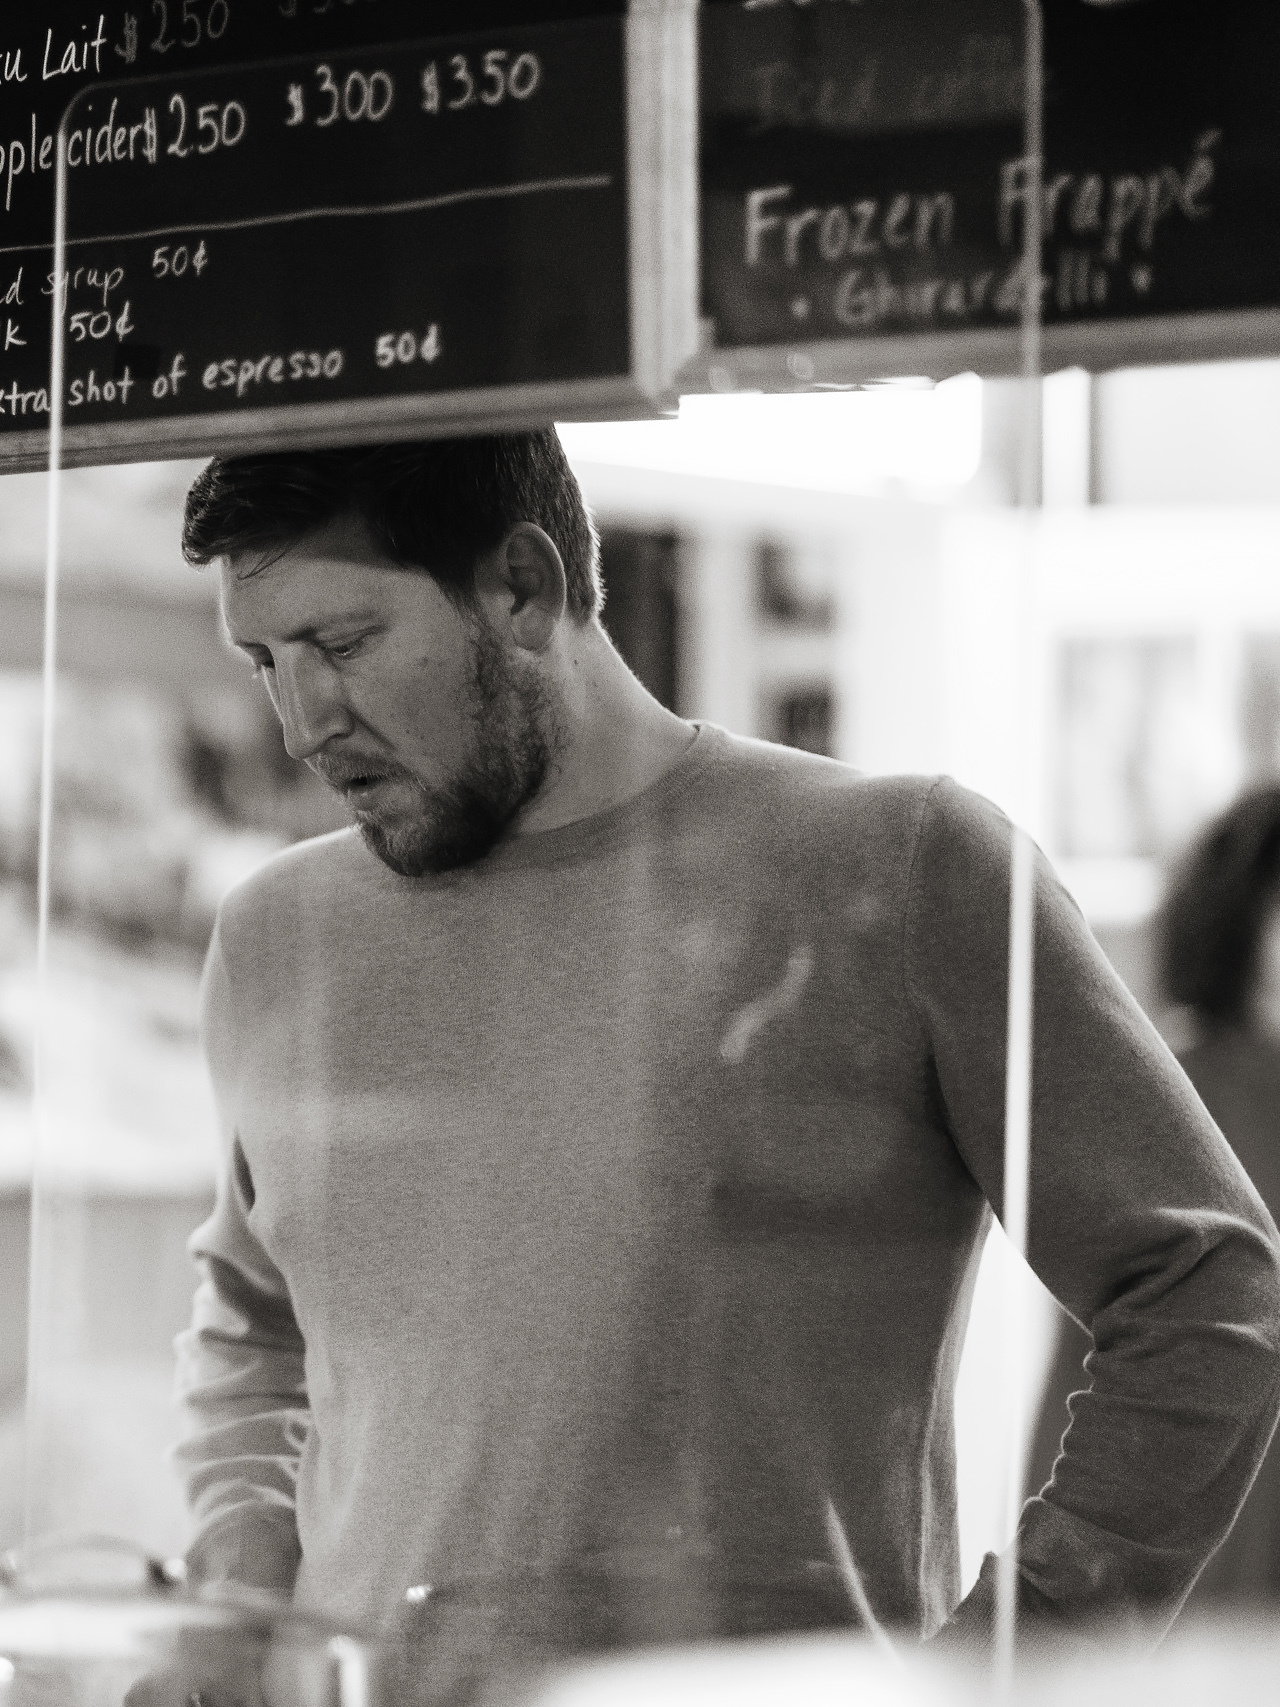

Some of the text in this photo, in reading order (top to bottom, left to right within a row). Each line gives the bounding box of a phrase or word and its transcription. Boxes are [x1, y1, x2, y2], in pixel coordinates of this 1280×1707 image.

[41, 15, 109, 84] Lait
[67, 97, 142, 166] cider
[743, 184, 956, 269] Frozen
[67, 367, 135, 407] shot
[151, 353, 197, 400] of
[202, 350, 346, 389] espresso
